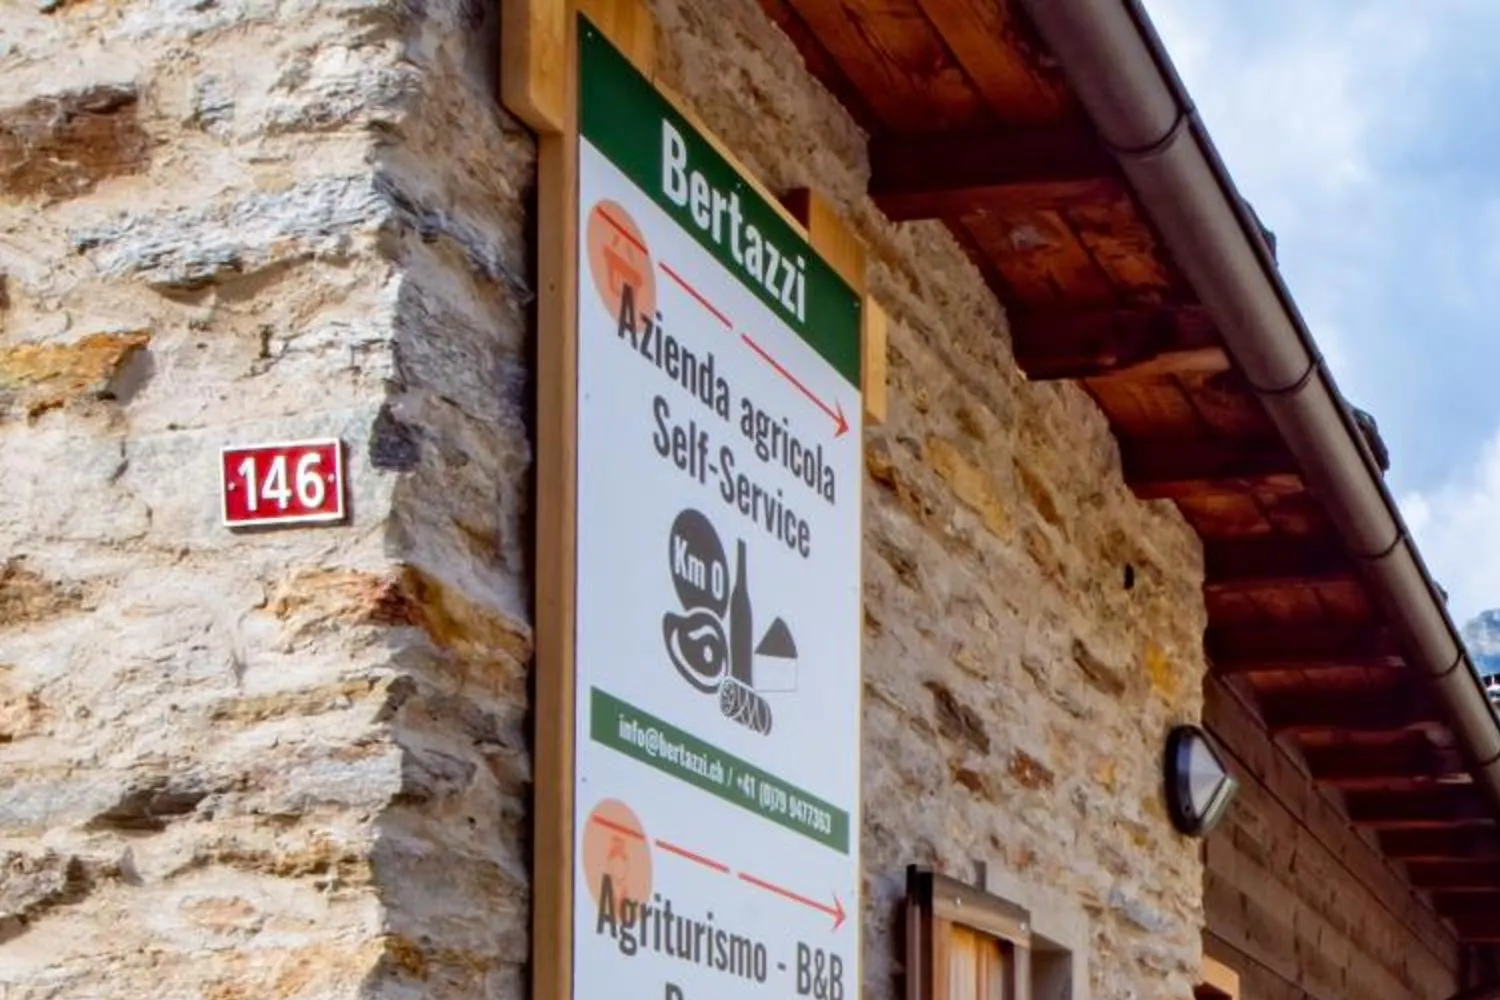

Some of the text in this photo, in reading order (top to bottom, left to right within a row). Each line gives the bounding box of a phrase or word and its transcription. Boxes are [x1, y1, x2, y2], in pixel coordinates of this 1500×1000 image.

[661, 117, 806, 324] Bertazzi
[618, 283, 836, 505] Azienda agricola
[238, 452, 325, 511] 146
[652, 394, 811, 558] Self-Service
[674, 535, 706, 592] Km
[618, 713, 724, 784] info@bertazzi.ch
[596, 874, 768, 984] Agriturismo
